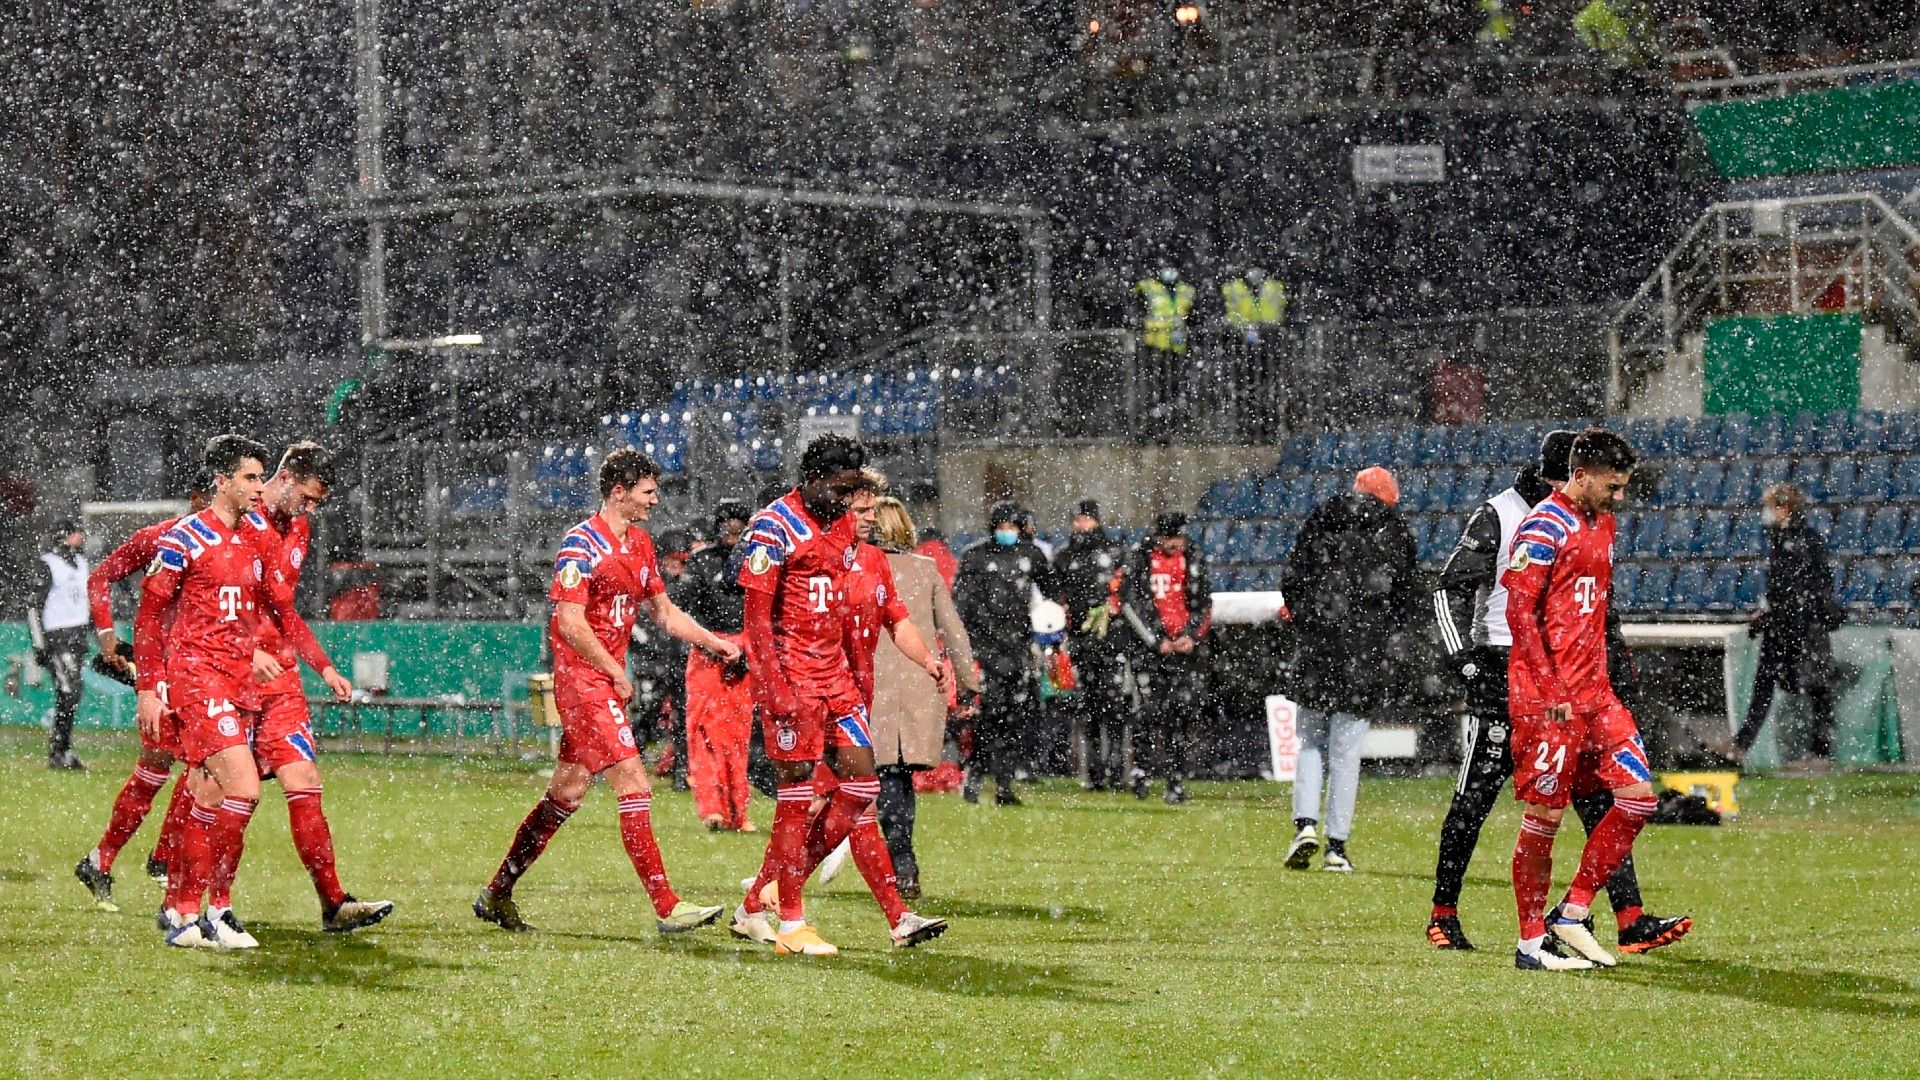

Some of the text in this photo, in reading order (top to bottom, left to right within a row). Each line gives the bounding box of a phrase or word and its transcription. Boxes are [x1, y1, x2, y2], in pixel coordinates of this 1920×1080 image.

[219, 585, 242, 621] T
[609, 594, 629, 627] T
[808, 576, 834, 613] T
[1574, 576, 1597, 614] T
[607, 699, 625, 724] 5
[1275, 704, 1297, 772] ERGO
[1533, 740, 1567, 774] 21
